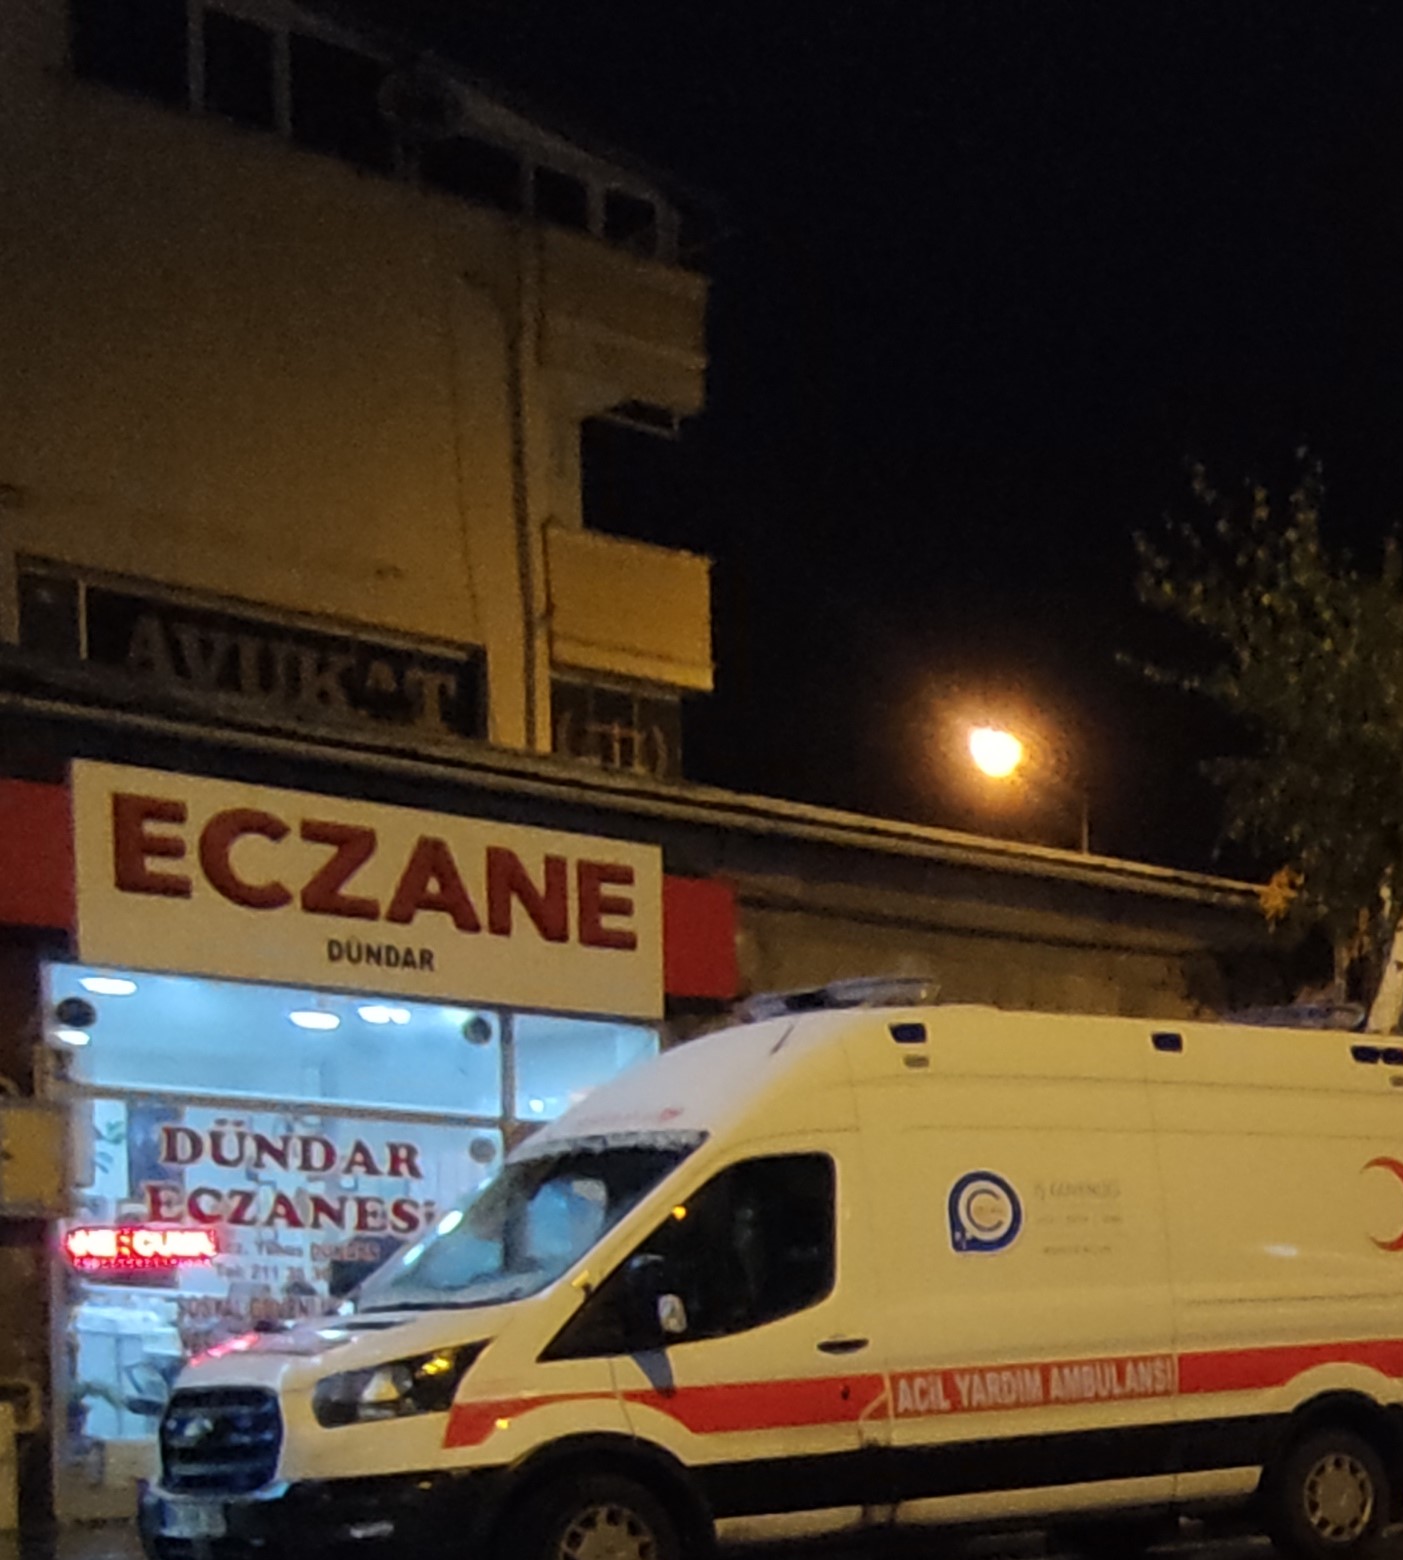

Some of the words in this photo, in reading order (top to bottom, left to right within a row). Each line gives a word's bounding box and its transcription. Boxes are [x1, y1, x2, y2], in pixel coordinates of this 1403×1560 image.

[111, 792, 638, 950] ECZANE
[328, 938, 434, 973] DÜNDAR
[161, 1119, 423, 1179] DÜNDAR
[956, 1367, 1044, 1407] YARDIM
[1050, 1358, 1174, 1398] AMBULANSI
